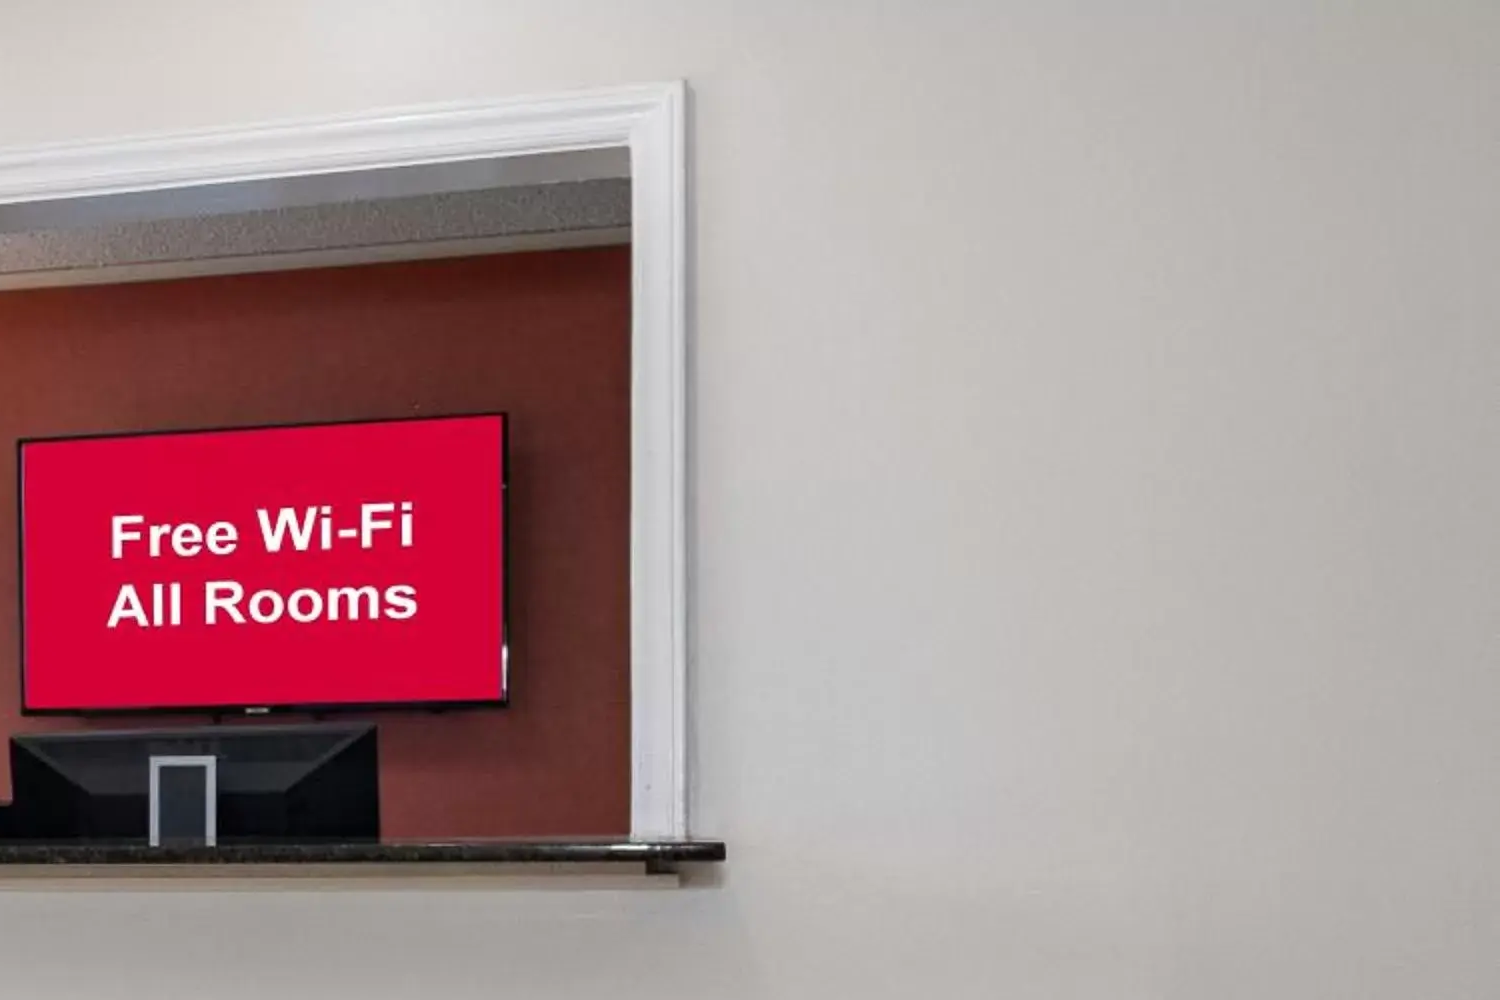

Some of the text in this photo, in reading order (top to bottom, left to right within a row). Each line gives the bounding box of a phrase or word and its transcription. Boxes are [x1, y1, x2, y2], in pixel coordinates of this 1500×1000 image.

[111, 502, 414, 559] Free Wi-Fi
[107, 580, 418, 628] All Rooms
